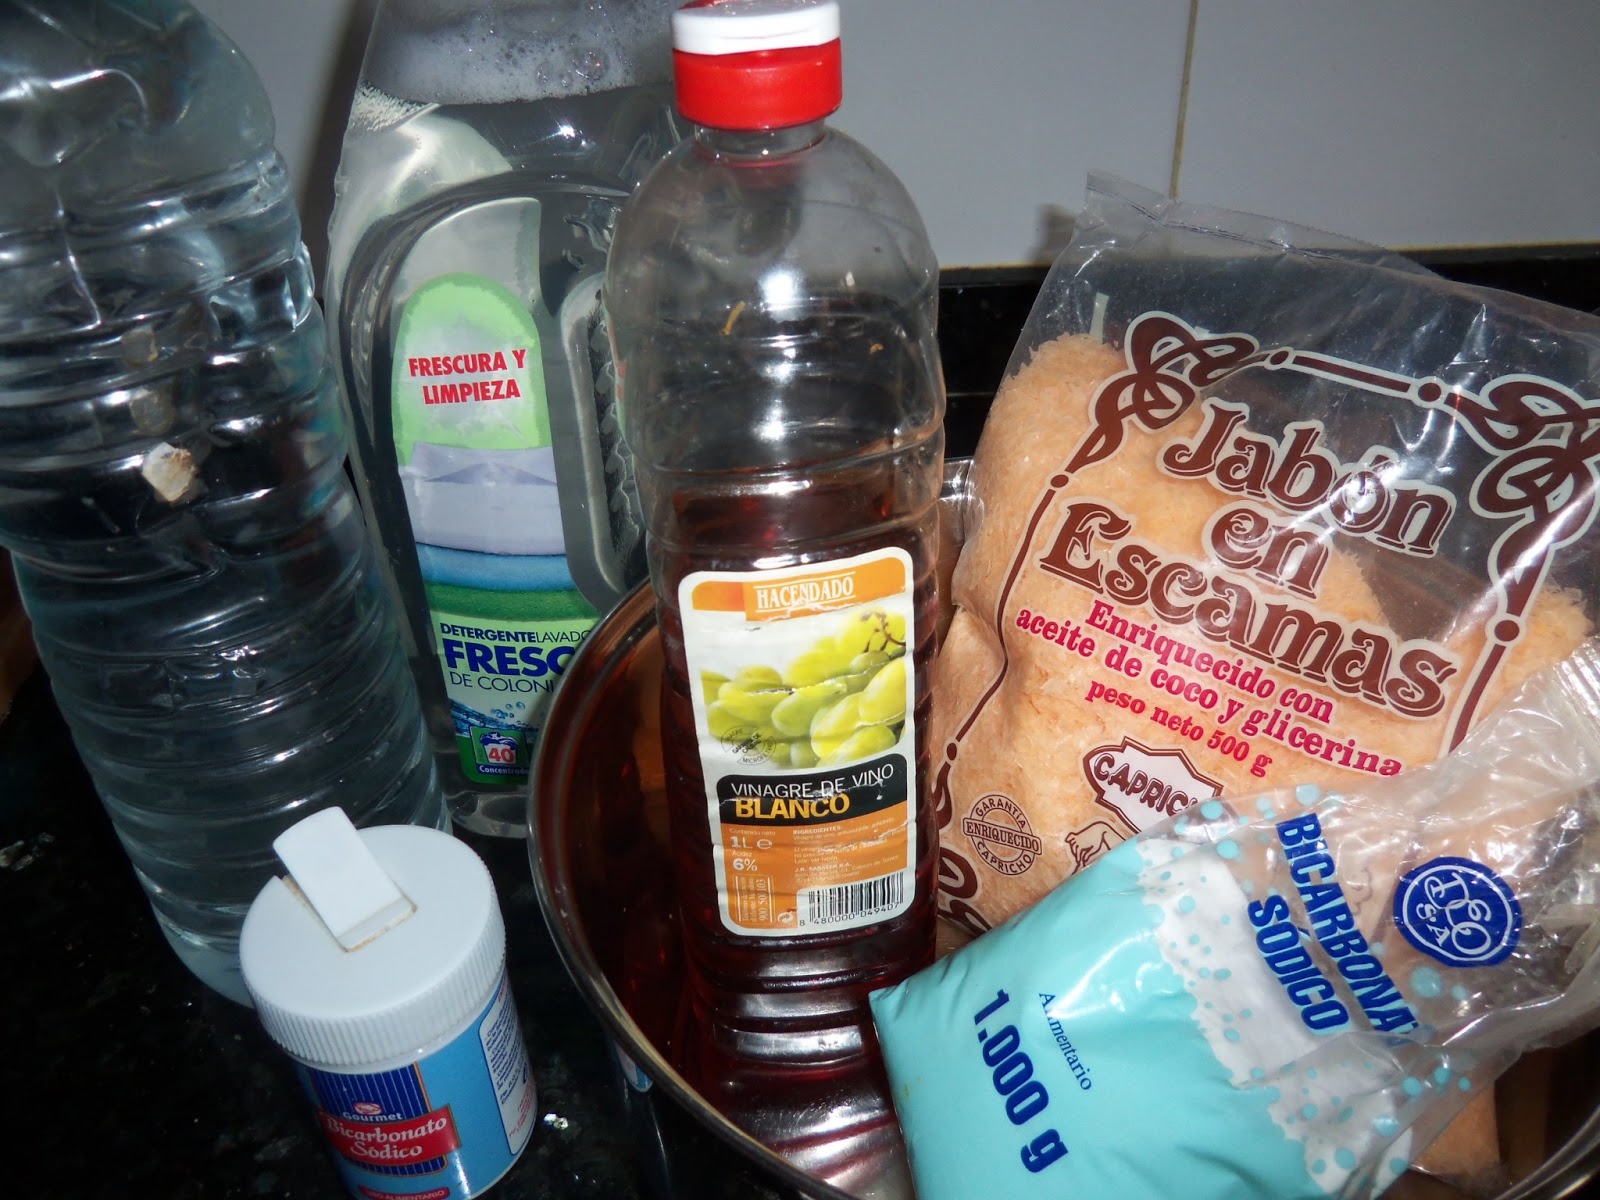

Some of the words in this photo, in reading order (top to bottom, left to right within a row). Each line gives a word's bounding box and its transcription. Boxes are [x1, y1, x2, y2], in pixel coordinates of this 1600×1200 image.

[408, 352, 505, 378] FRESCURA
[511, 349, 526, 370] Y
[422, 378, 520, 405] LIMPIEZA
[1162, 402, 1451, 557] Jabón
[1210, 507, 1328, 599] en
[757, 576, 854, 609] HACENDADO
[1039, 503, 1456, 718] Escamas
[440, 622, 536, 643] DETERGENTE
[1084, 599, 1276, 699] Enriquecido
[1279, 688, 1335, 724] con
[450, 671, 472, 688] DE
[1016, 608, 1096, 658] aceite
[1104, 644, 1143, 678] de
[1150, 668, 1219, 710] coco
[1217, 697, 1245, 725] y
[1244, 708, 1402, 778] glicerina
[1085, 680, 1146, 715] peso
[1153, 705, 1204, 741] neto
[1207, 729, 1250, 762] 500
[1251, 753, 1273, 779] g
[488, 747, 515, 763] 40
[731, 781, 813, 798] VINAGRE
[821, 777, 845, 797] DE
[852, 763, 894, 788] VINO
[735, 793, 850, 819] BLANCO
[975, 797, 1026, 829] GARANTÍA
[966, 821, 1039, 852] ENRIQUECIDO
[733, 857, 758, 871] 6%
[977, 841, 1032, 873] CAPRICHO
[814, 913, 855, 925] 480000
[860, 901, 900, 918] 049407
[1276, 813, 1419, 1034] BICARBONA
[1039, 992, 1092, 1091] Amentario
[974, 988, 1049, 1125] 1.000
[1020, 1128, 1069, 1173] g
[326, 1116, 447, 1143] Bicarbonato
[342, 1112, 403, 1123] Gourmet
